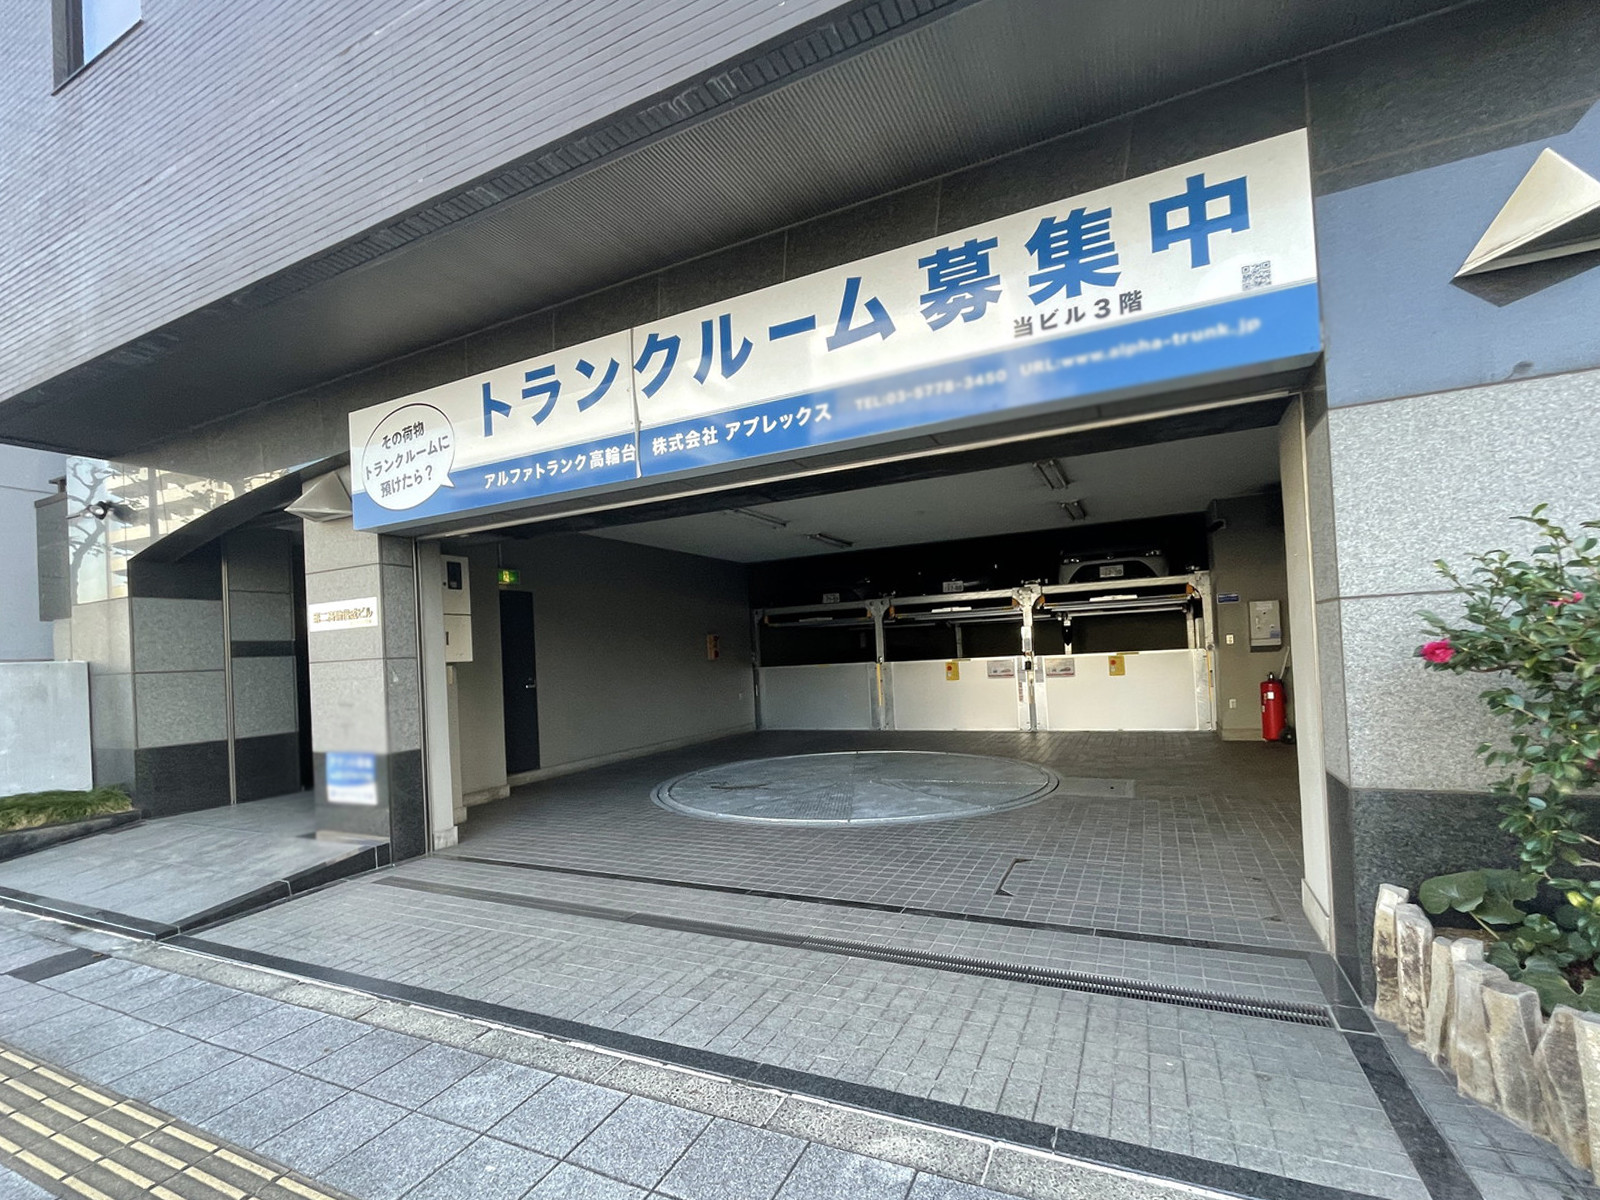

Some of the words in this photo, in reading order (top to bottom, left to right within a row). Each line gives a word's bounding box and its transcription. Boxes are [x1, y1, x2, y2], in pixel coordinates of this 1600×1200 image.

[481, 172, 1251, 438] トランクルーム募集中
[365, 435, 450, 480] トランクルームに
[381, 421, 425, 449] その荷物
